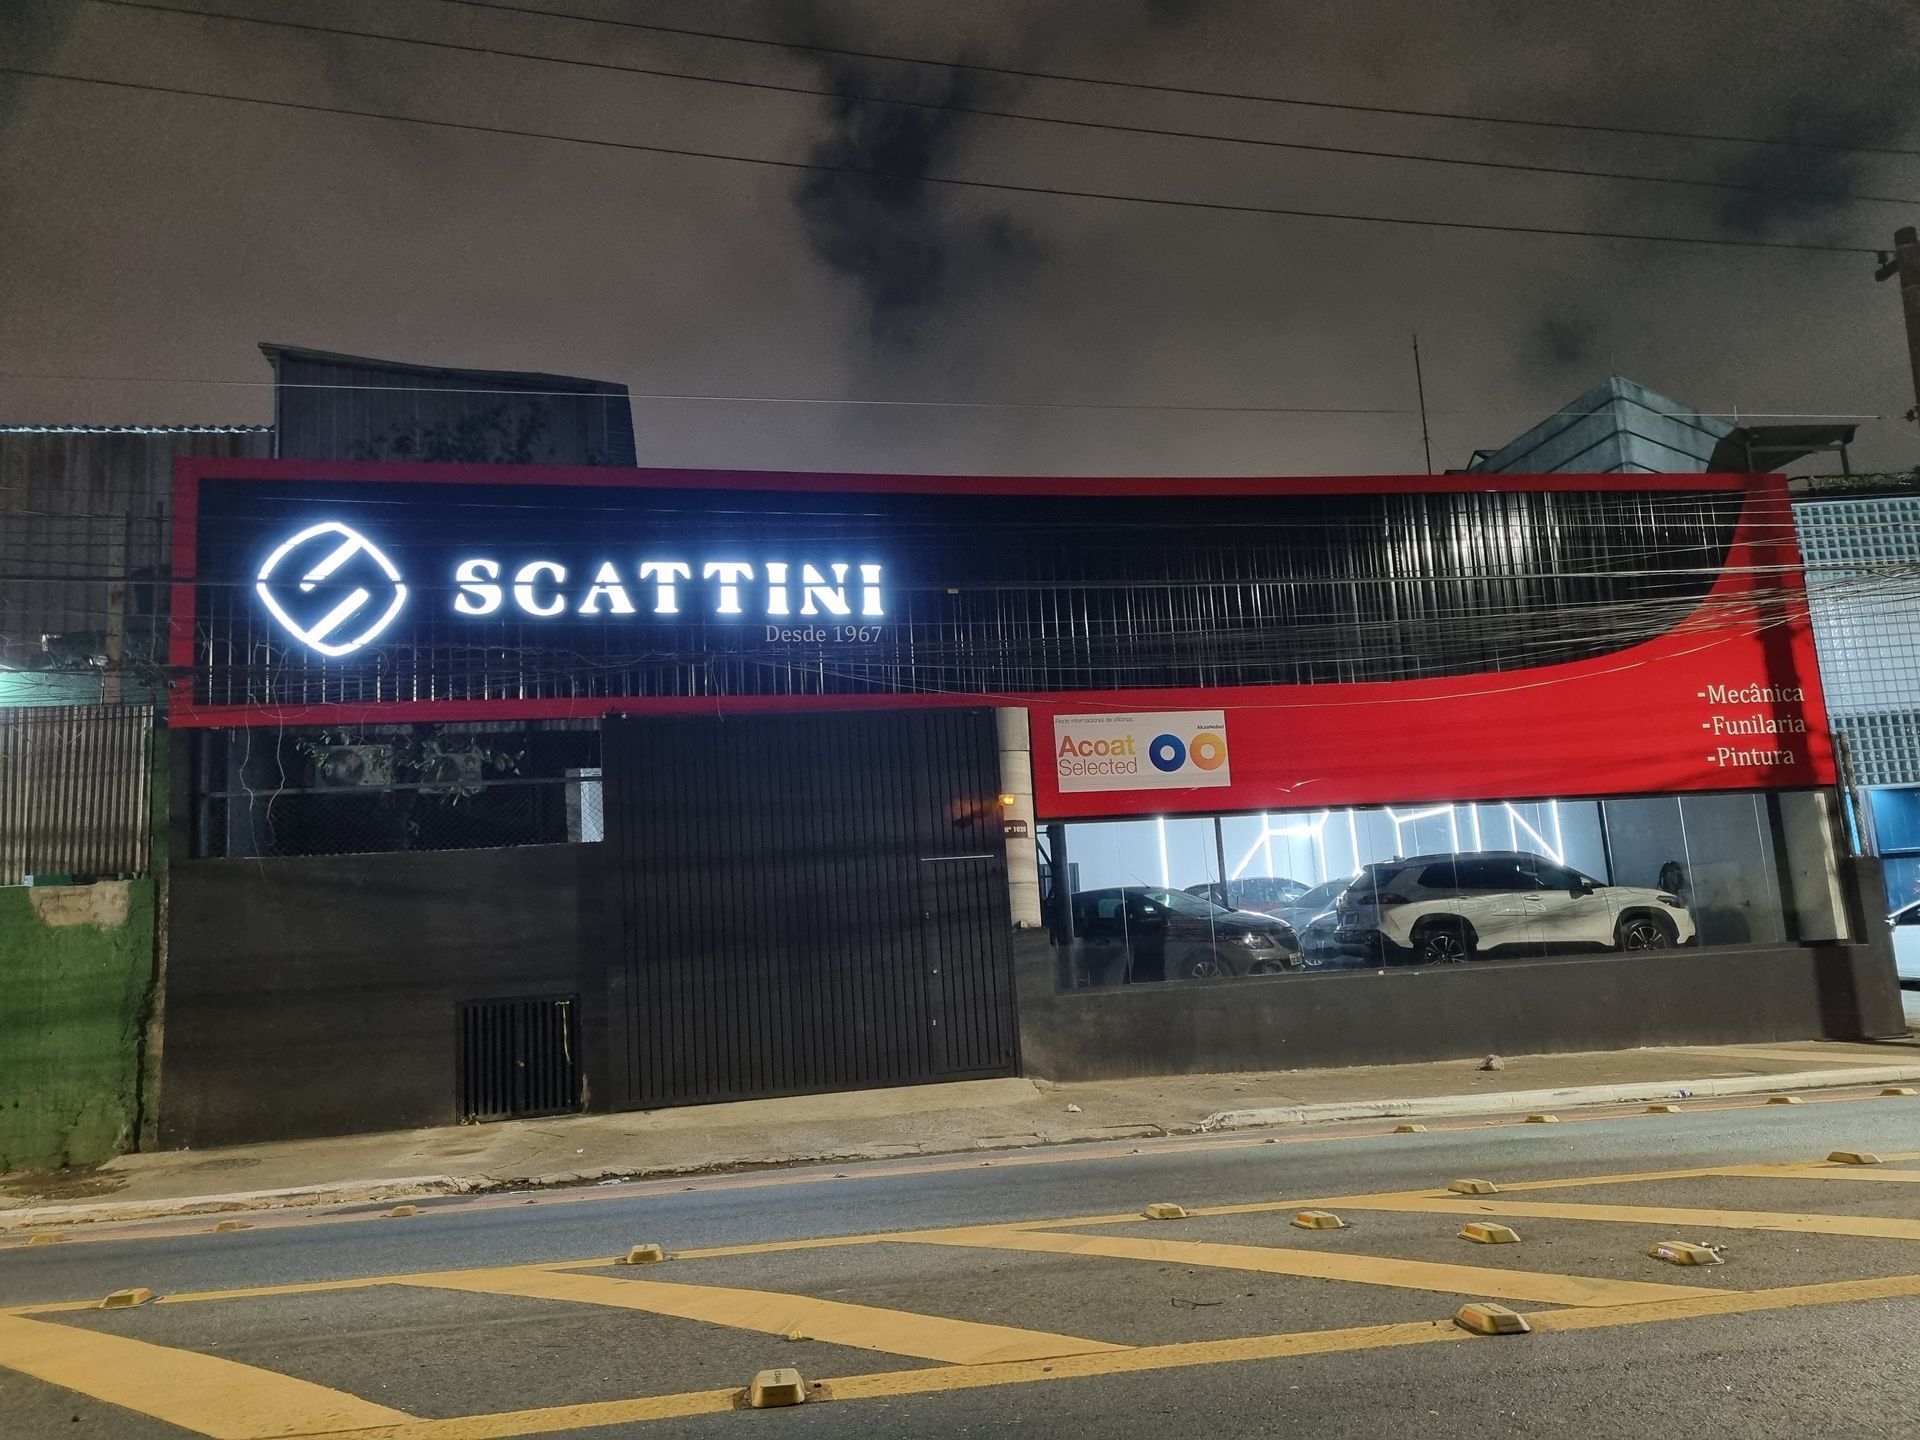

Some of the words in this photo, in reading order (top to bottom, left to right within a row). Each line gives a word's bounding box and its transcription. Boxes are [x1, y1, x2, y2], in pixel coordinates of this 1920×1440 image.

[453, 558, 885, 616] SCATTINI
[765, 625, 826, 643] Desde
[833, 625, 883, 643] 1967
[1058, 734, 1136, 757] Acoat
[1058, 757, 1137, 776] Selected
